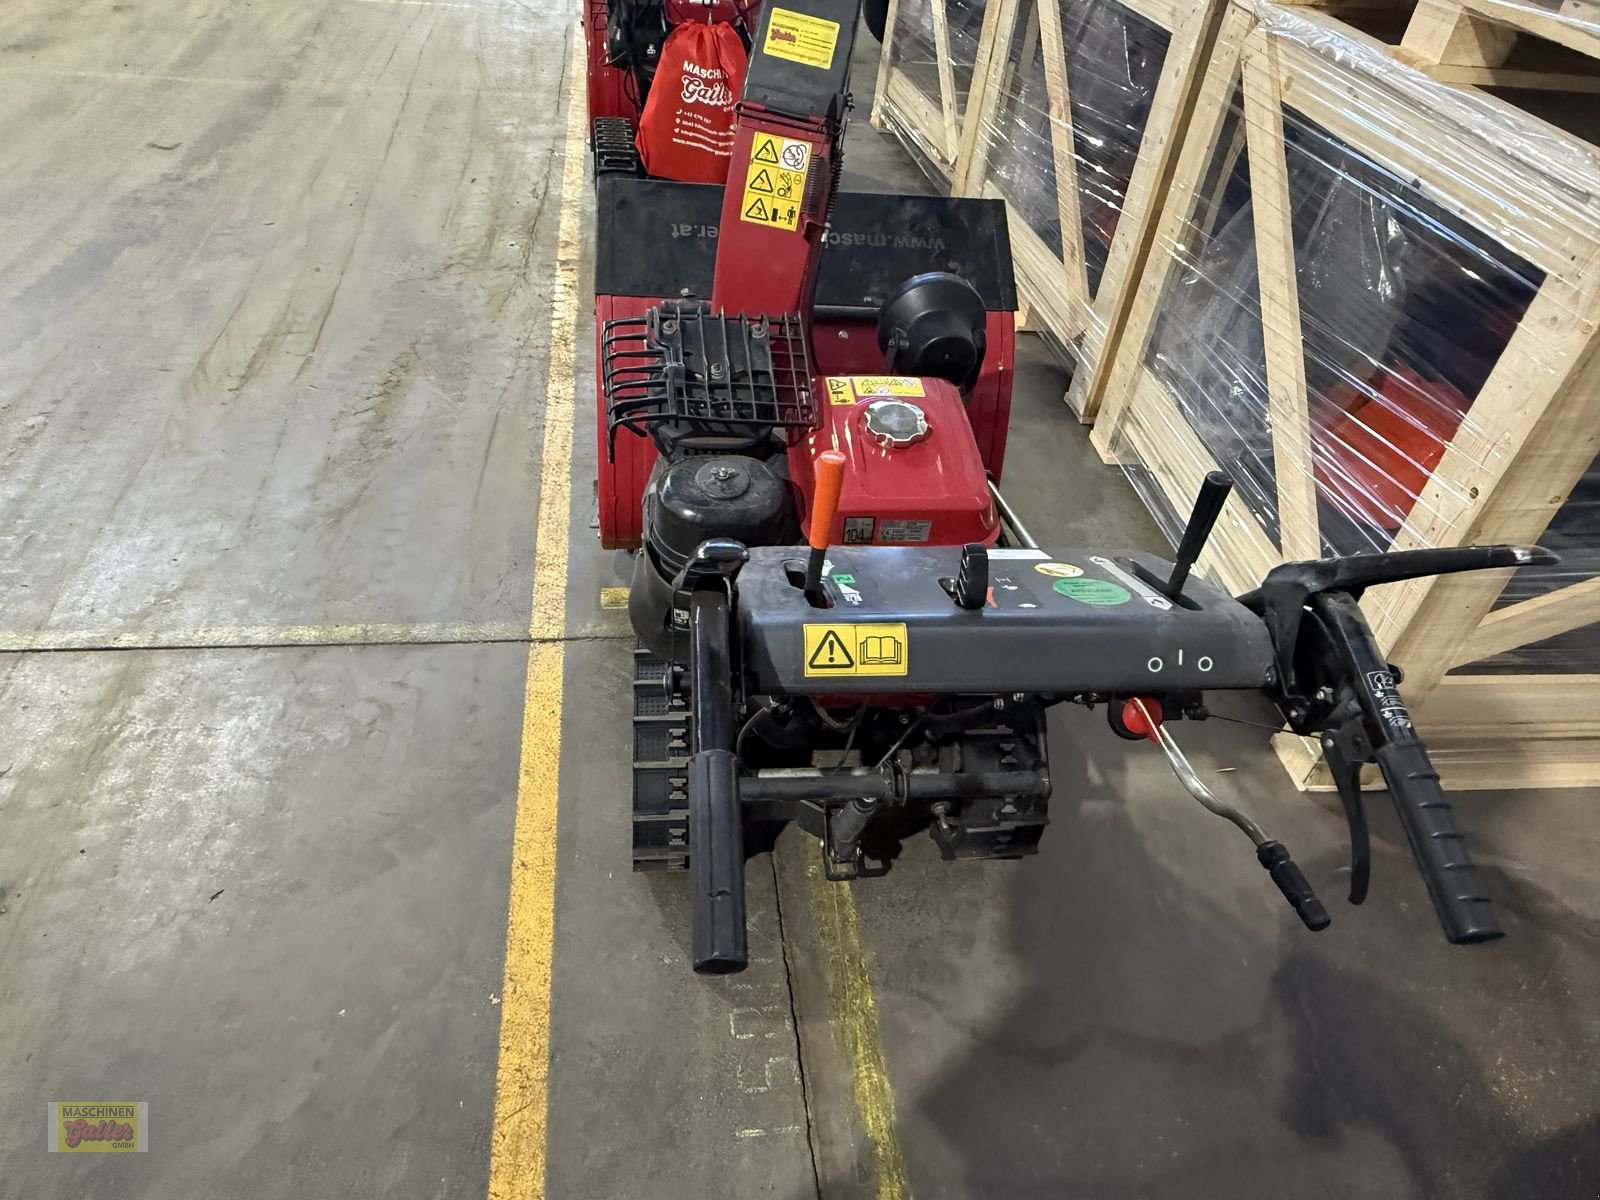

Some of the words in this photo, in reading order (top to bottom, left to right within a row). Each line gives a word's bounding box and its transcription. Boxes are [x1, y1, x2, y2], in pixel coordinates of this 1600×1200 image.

[670, 223, 719, 239] er.at
[826, 231, 946, 250] www.masc
[846, 528, 865, 542] 104
